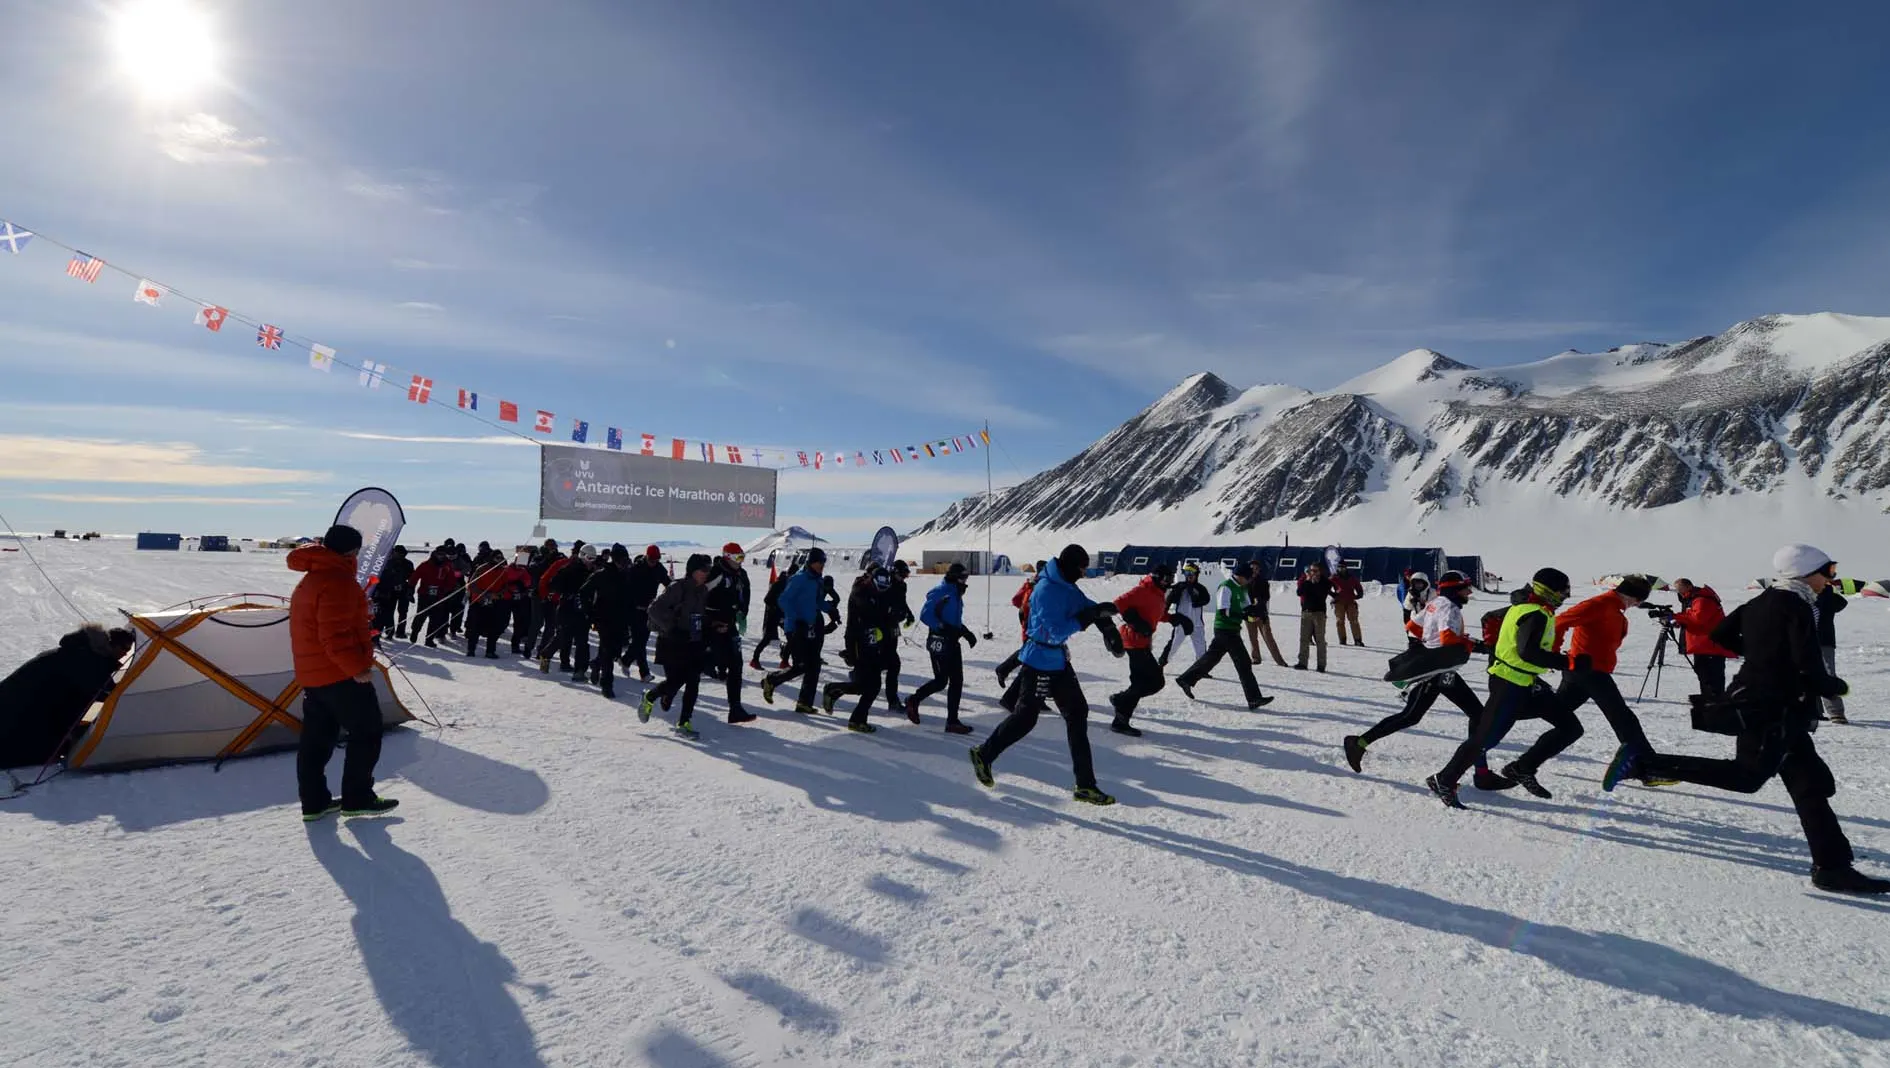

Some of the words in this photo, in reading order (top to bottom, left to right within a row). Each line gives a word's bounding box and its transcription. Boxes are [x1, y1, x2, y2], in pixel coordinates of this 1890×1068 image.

[575, 480, 642, 496] Antarctic
[646, 485, 665, 498] Ice
[668, 486, 725, 502] Marathon
[727, 491, 736, 503] &
[739, 492, 765, 505] 100k
[930, 641, 943, 652] 49
